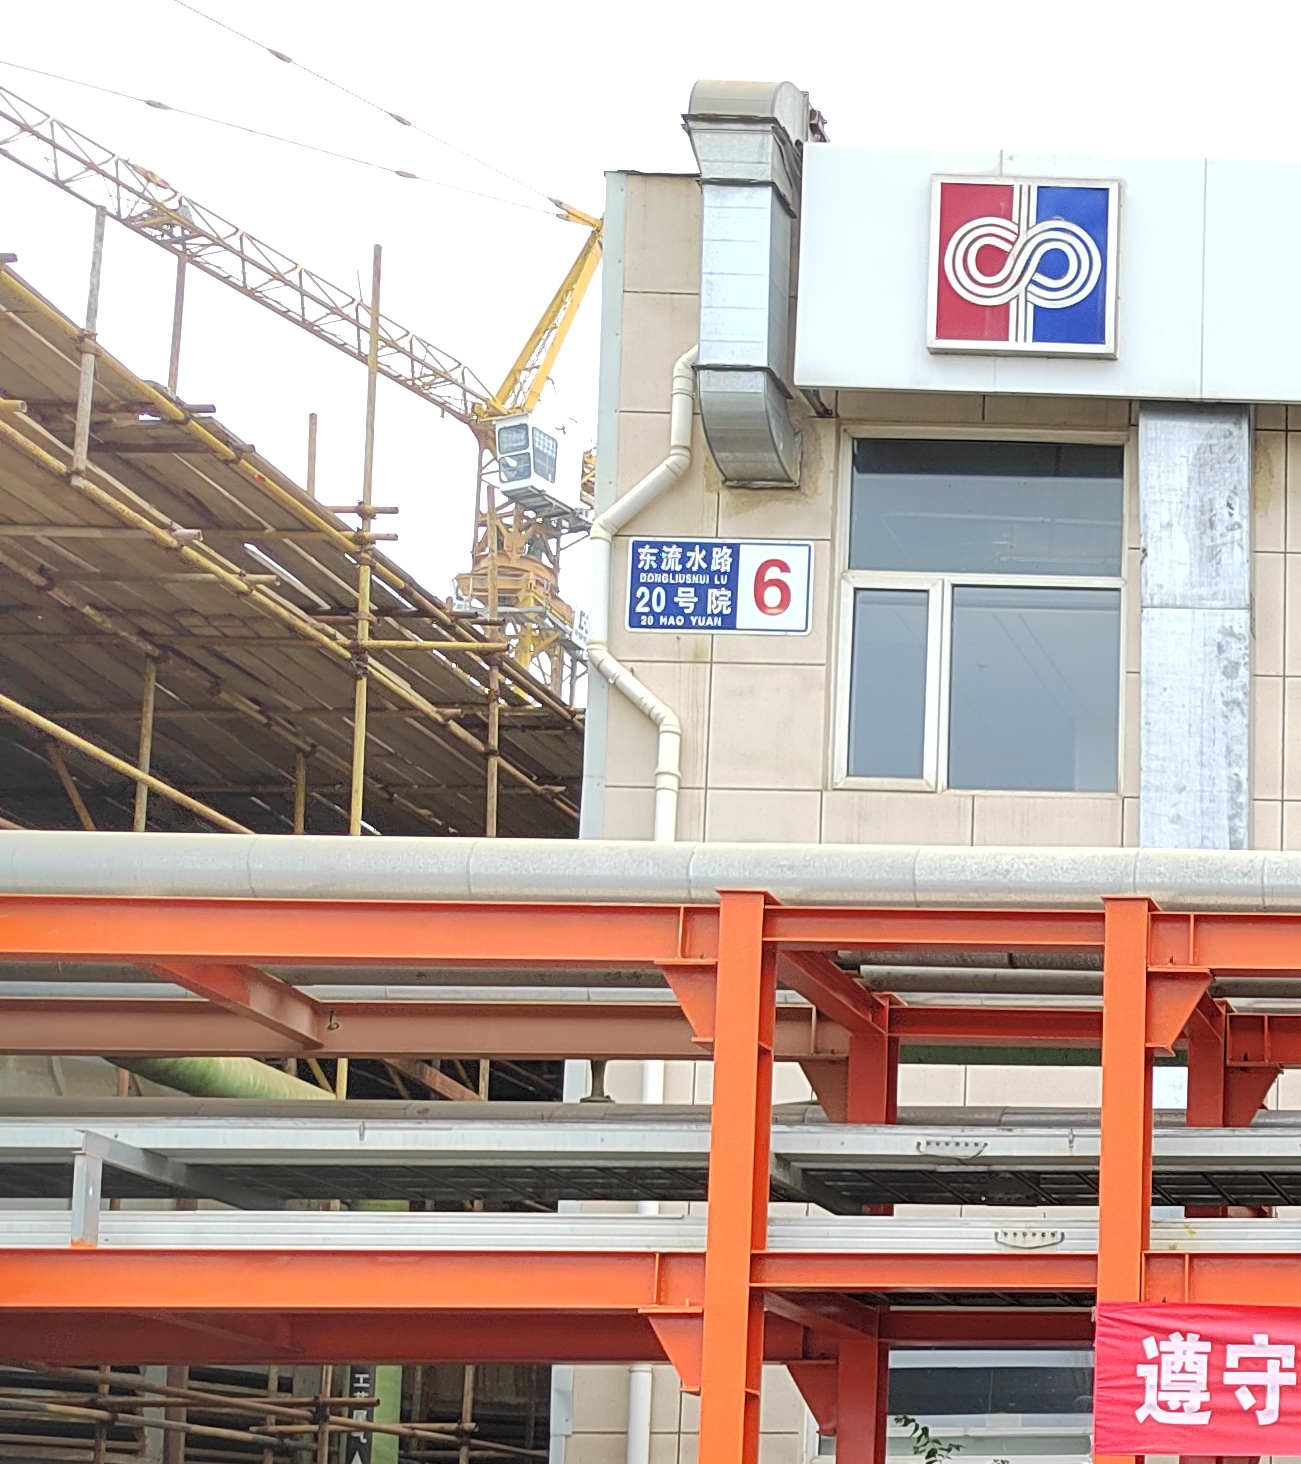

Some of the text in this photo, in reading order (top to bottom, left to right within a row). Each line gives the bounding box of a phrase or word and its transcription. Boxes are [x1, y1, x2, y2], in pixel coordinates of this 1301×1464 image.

[637, 544, 733, 573] 东流水路
[640, 573, 728, 584] DONGLIUSHUI LU
[753, 558, 791, 616] 6
[641, 616, 722, 627] 20 HAO YUAN
